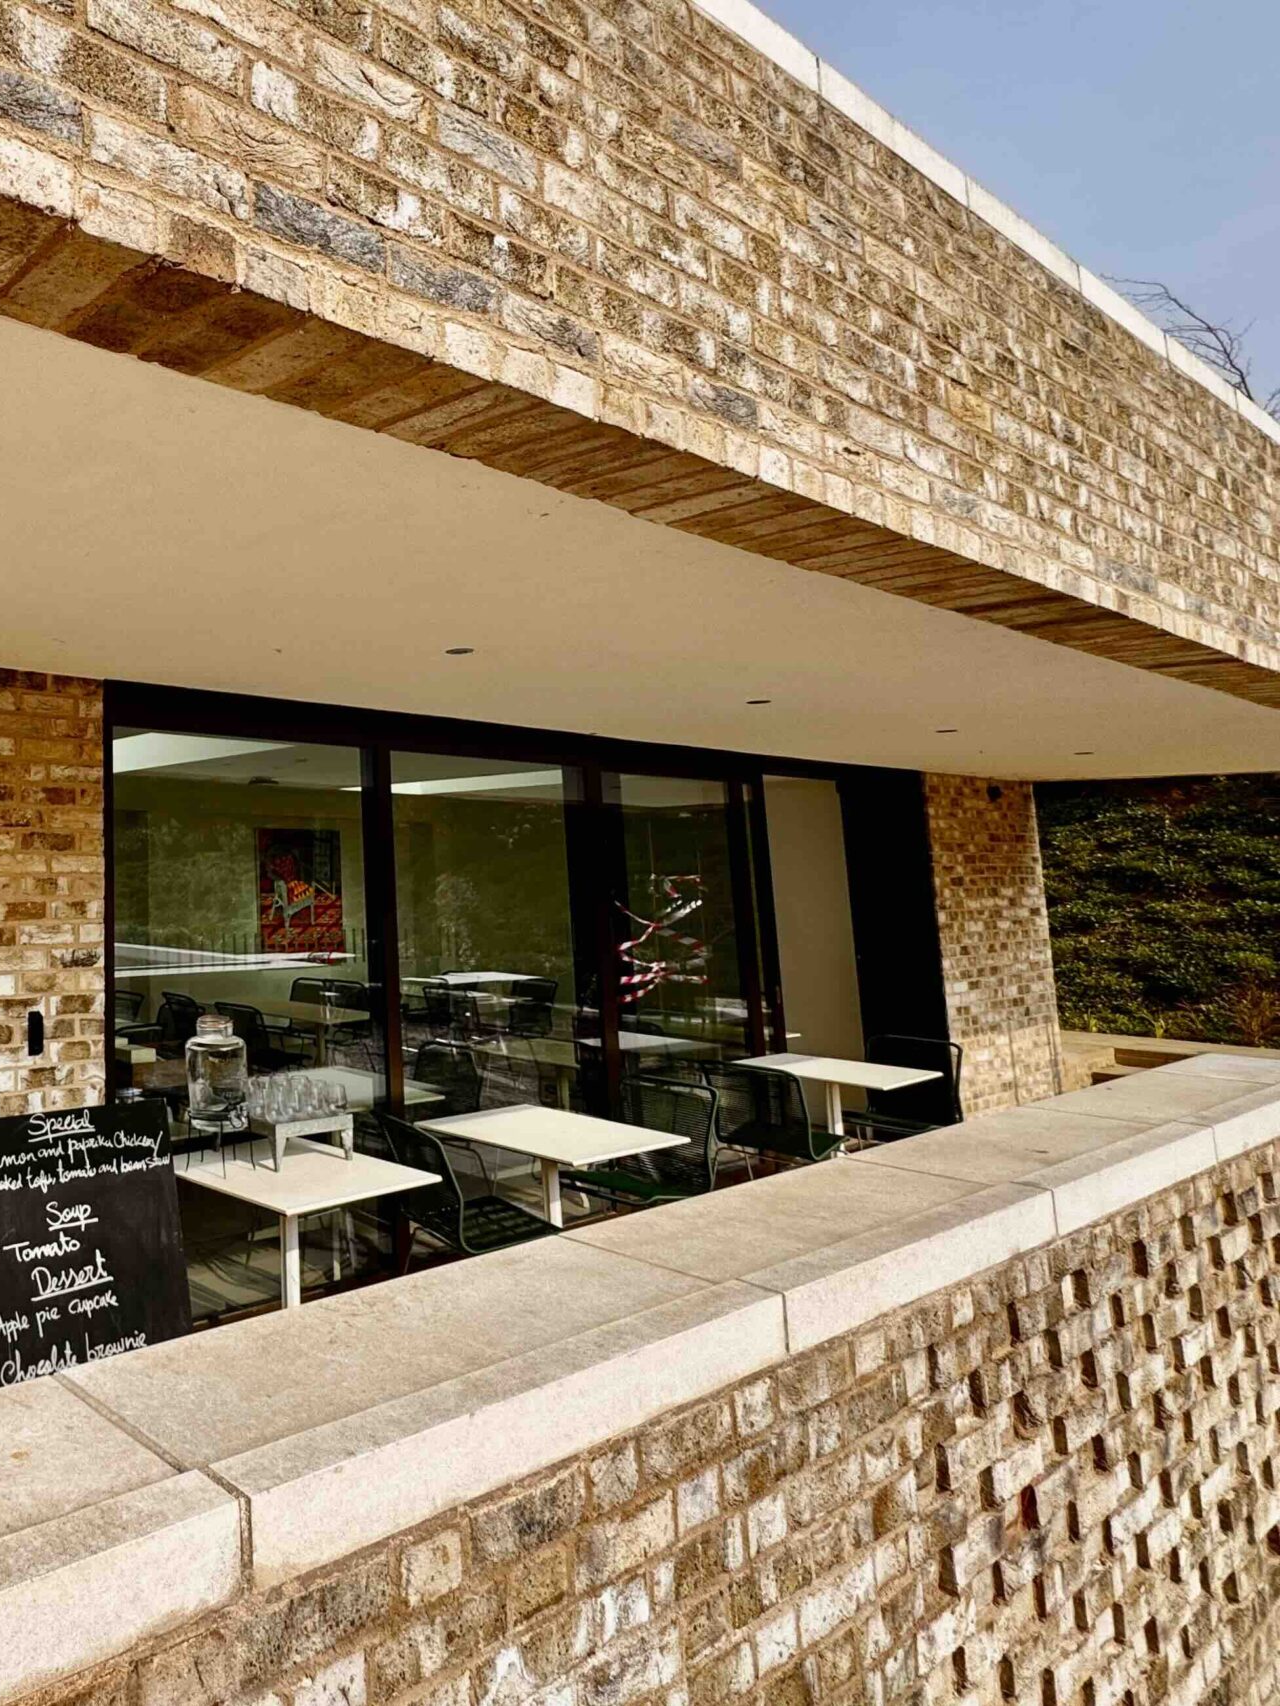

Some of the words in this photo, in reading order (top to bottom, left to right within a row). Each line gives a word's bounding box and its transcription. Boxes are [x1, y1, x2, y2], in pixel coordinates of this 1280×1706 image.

[28, 1109, 95, 1143] Special
[38, 1141, 65, 1157] and
[58, 1160, 96, 1183] tomato
[99, 1159, 119, 1174] and
[46, 1201, 91, 1231] Soup
[3, 1231, 80, 1262] Tomato
[31, 1249, 108, 1295] Dessert
[35, 1306, 61, 1338] pie
[0, 1340, 80, 1387] Chocolate
[85, 1330, 148, 1361] brownie
